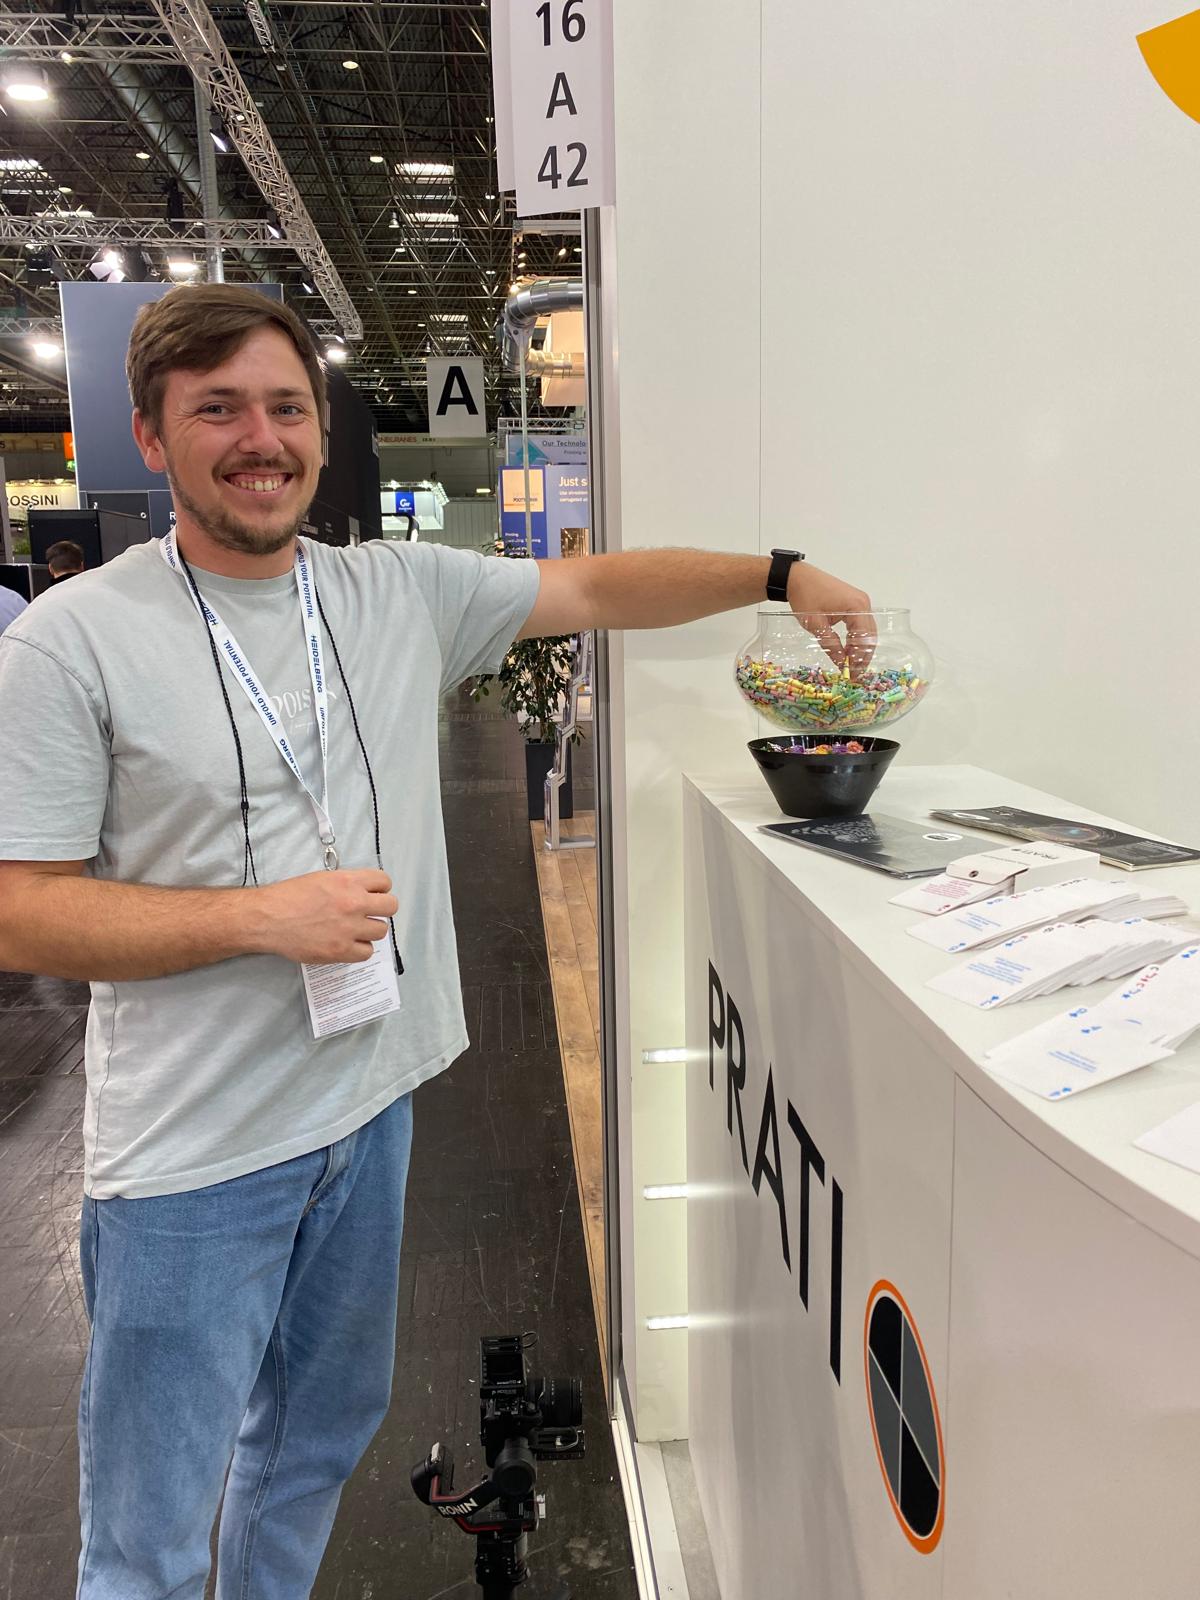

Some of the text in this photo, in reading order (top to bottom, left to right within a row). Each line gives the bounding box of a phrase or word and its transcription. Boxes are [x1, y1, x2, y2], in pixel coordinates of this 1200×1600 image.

[536, 0, 586, 46] 16
[546, 72, 577, 119] A
[537, 142, 589, 190] 42
[436, 366, 479, 415] A
[8, 494, 59, 507] OSSINI
[559, 476, 579, 487] Just
[300, 563, 309, 582] YOUR
[302, 583, 314, 619] POTENTIAL
[223, 639, 278, 726] UNFOLD YOUR POTENTIAL
[310, 634, 324, 693] HEIDELBERG
[707, 957, 844, 1387] PRATI
[438, 1497, 479, 1516] RONIN
